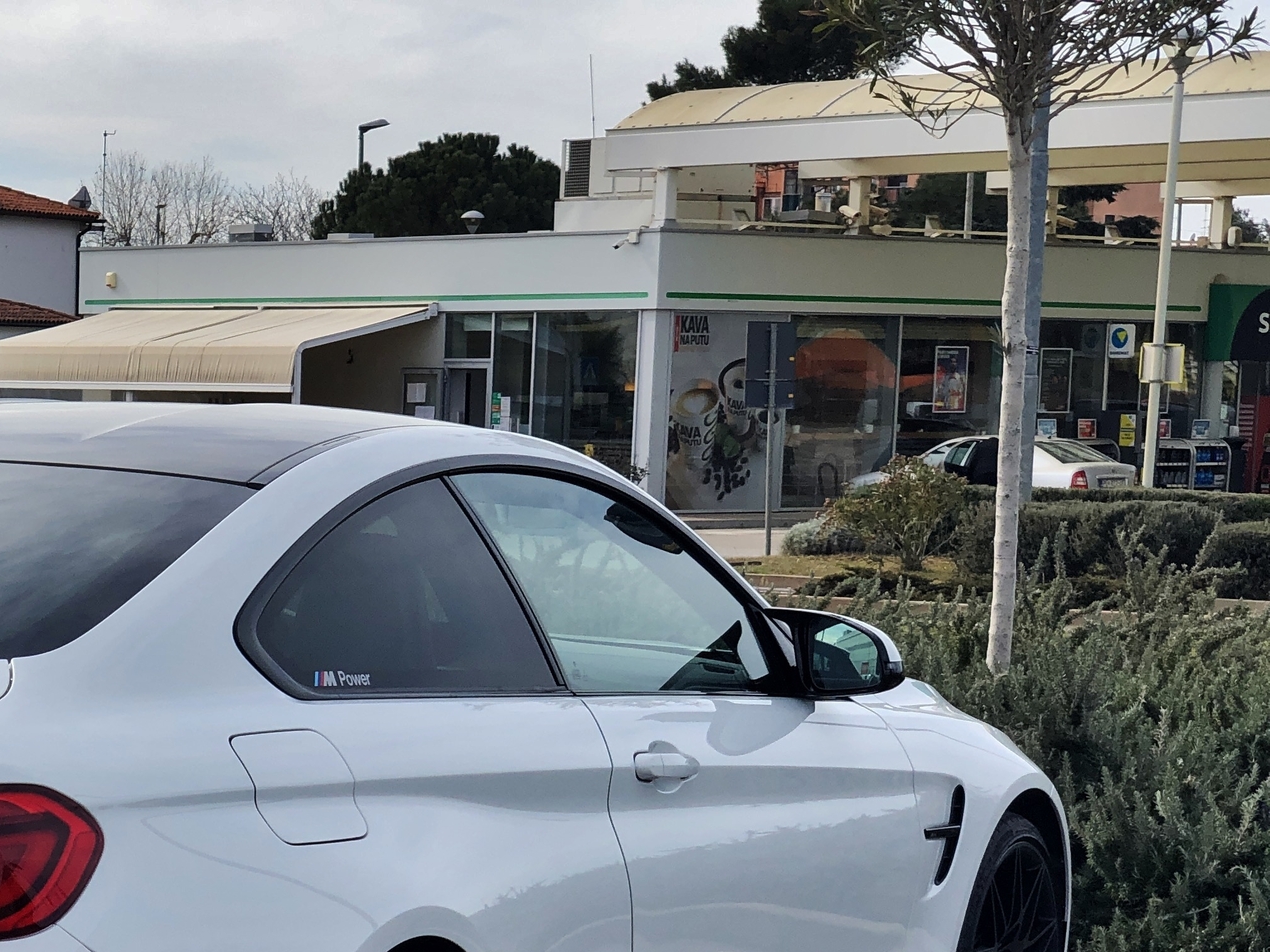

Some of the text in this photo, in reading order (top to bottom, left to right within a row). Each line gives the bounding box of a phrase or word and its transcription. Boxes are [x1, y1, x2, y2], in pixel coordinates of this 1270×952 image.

[680, 315, 709, 334] KAVA
[679, 334, 710, 346] NA PUTU
[337, 670, 371, 687] Power
